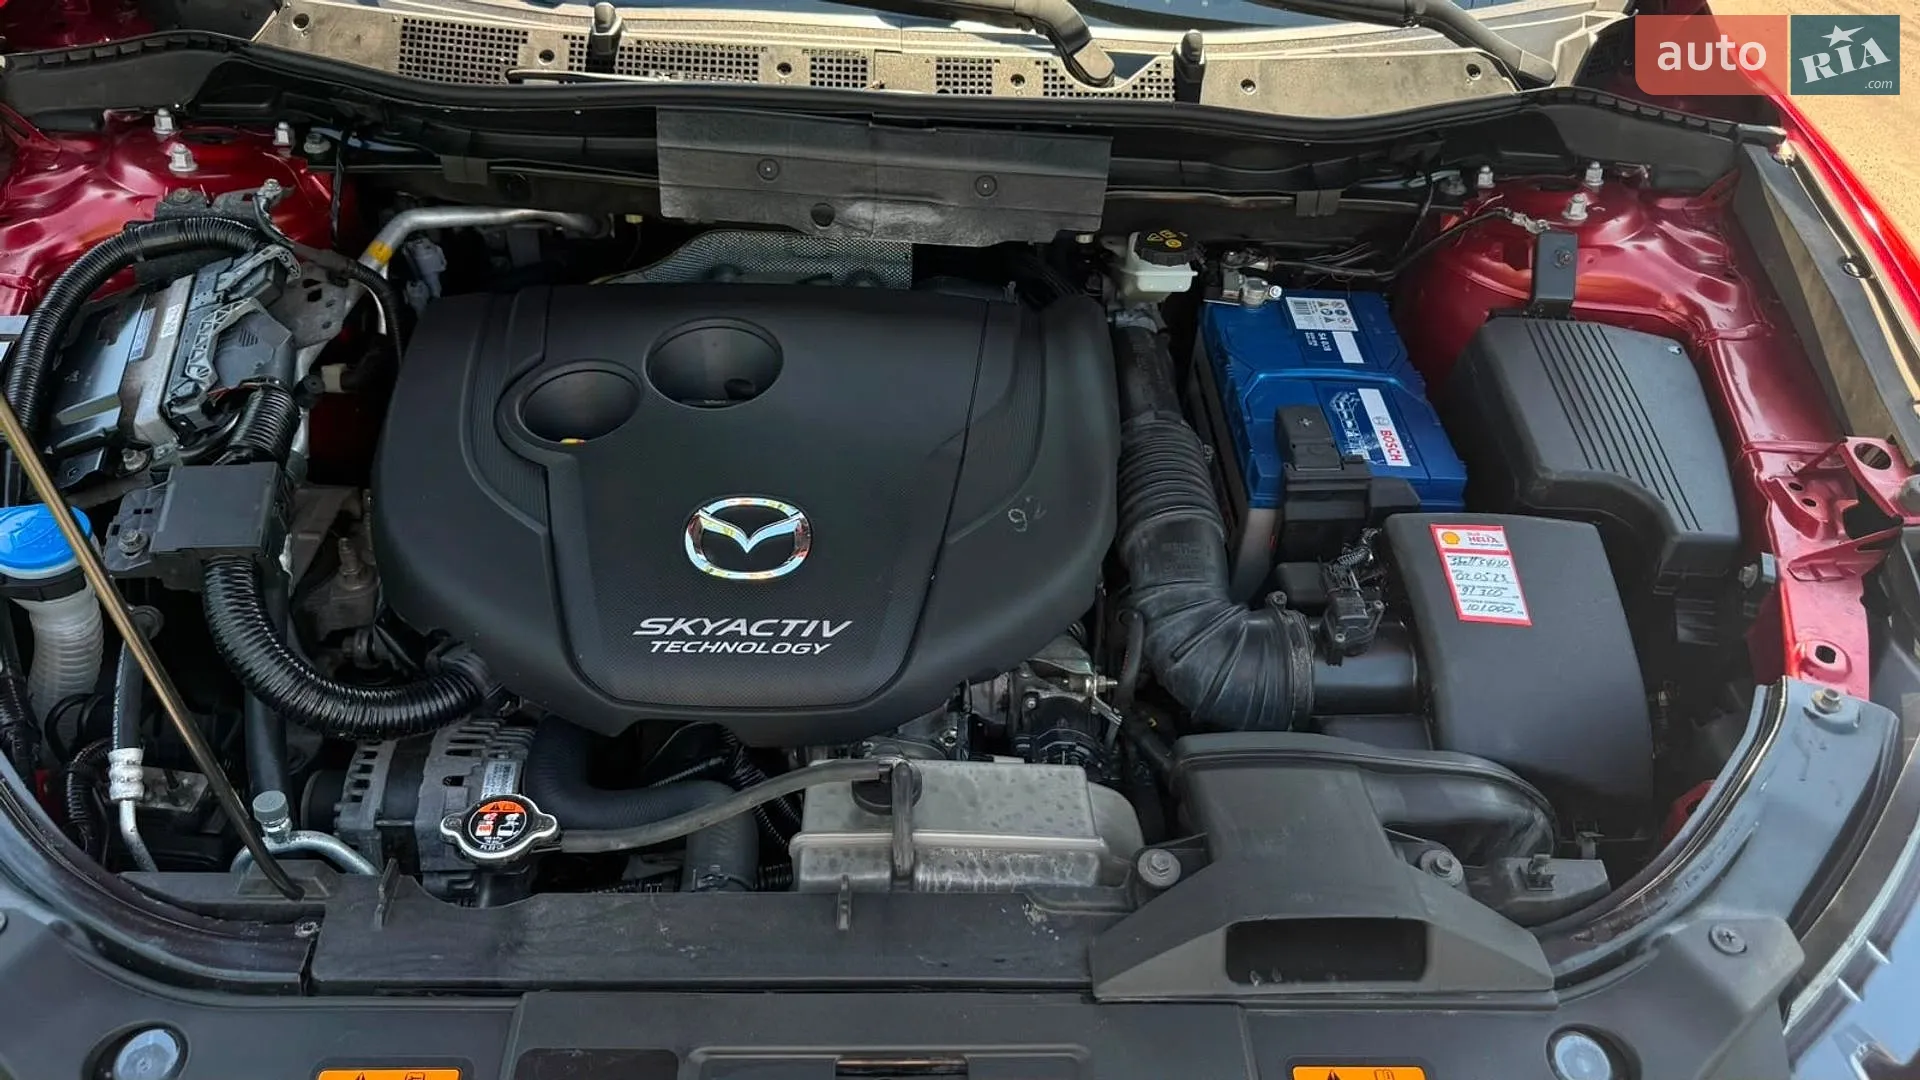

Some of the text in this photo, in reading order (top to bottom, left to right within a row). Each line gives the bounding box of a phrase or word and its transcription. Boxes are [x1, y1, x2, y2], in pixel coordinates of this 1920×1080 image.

[1380, 430, 1403, 462] BOSCH
[633, 617, 853, 638] SKYACTIV
[650, 641, 832, 655] TECHNOLOGY
